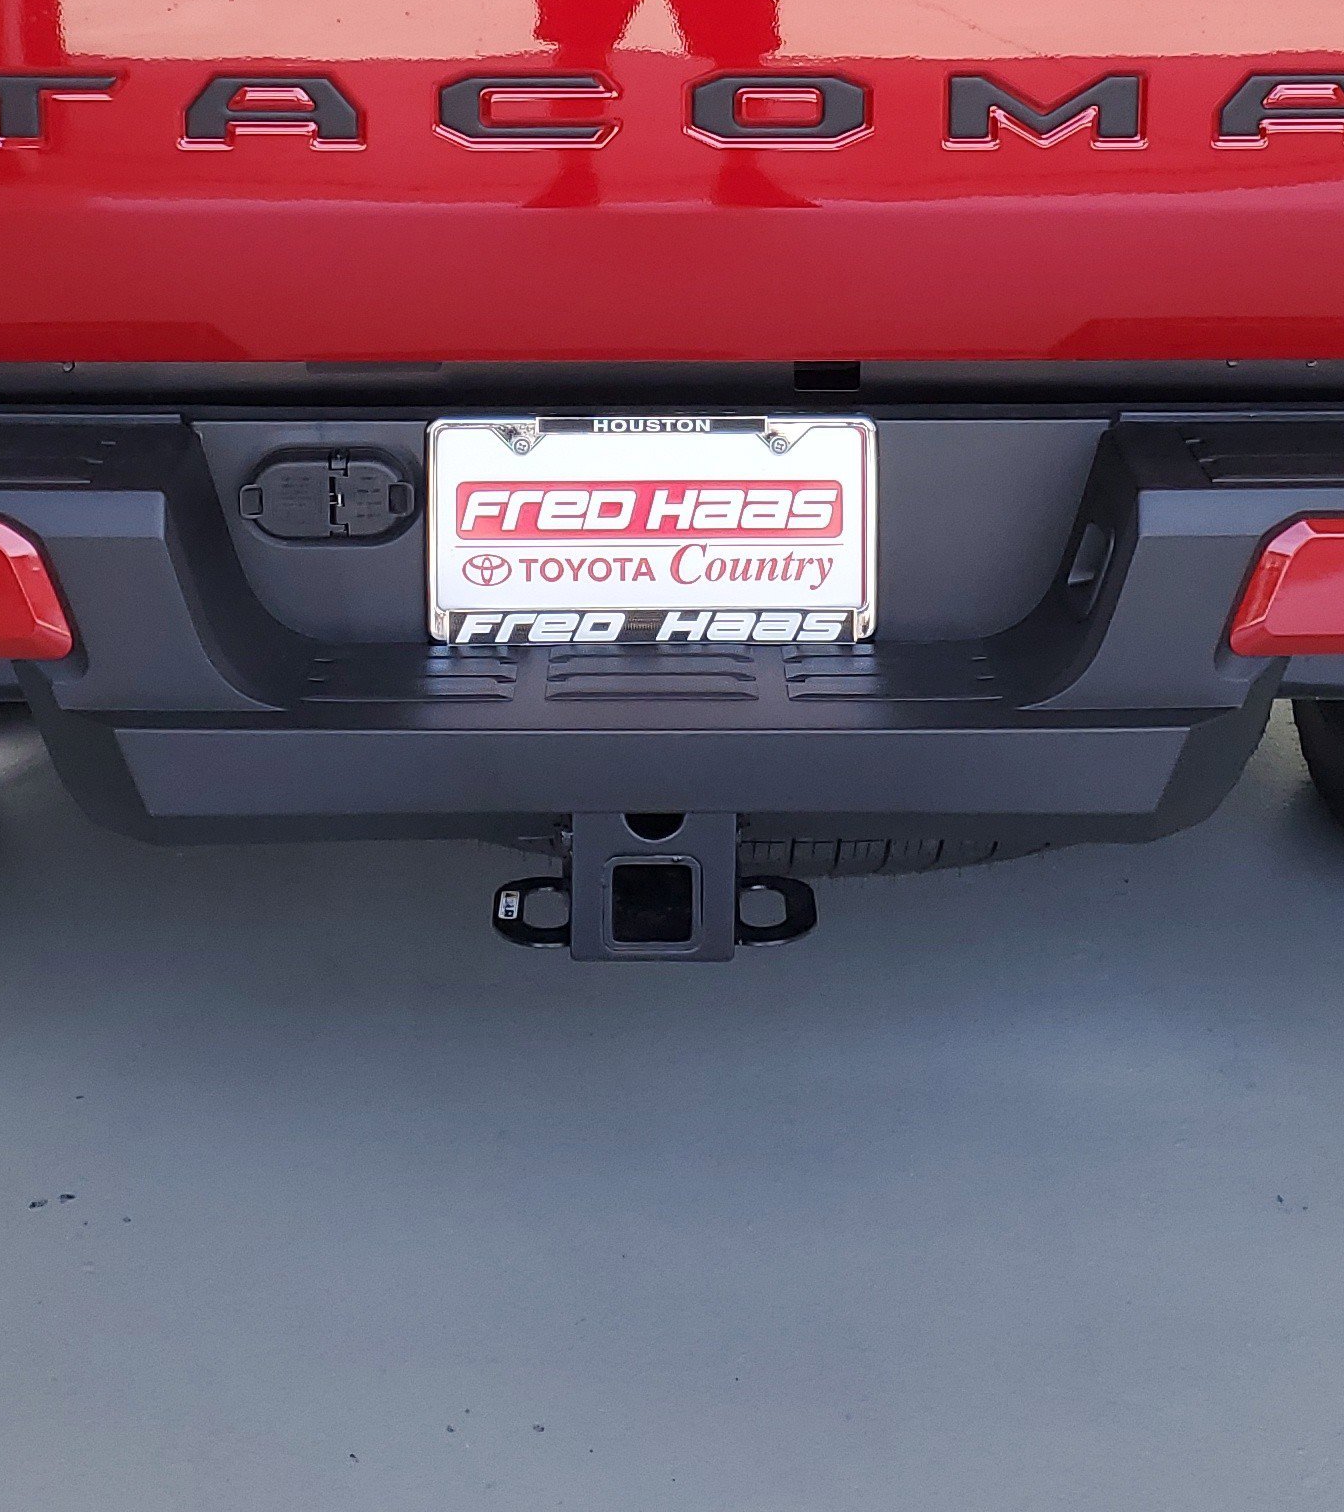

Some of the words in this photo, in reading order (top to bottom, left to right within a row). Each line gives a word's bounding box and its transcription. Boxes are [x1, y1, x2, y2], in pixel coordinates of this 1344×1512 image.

[592, 419, 712, 433] HOUSTON
[518, 557, 656, 582] TOYOTA
[669, 543, 834, 590] Country
